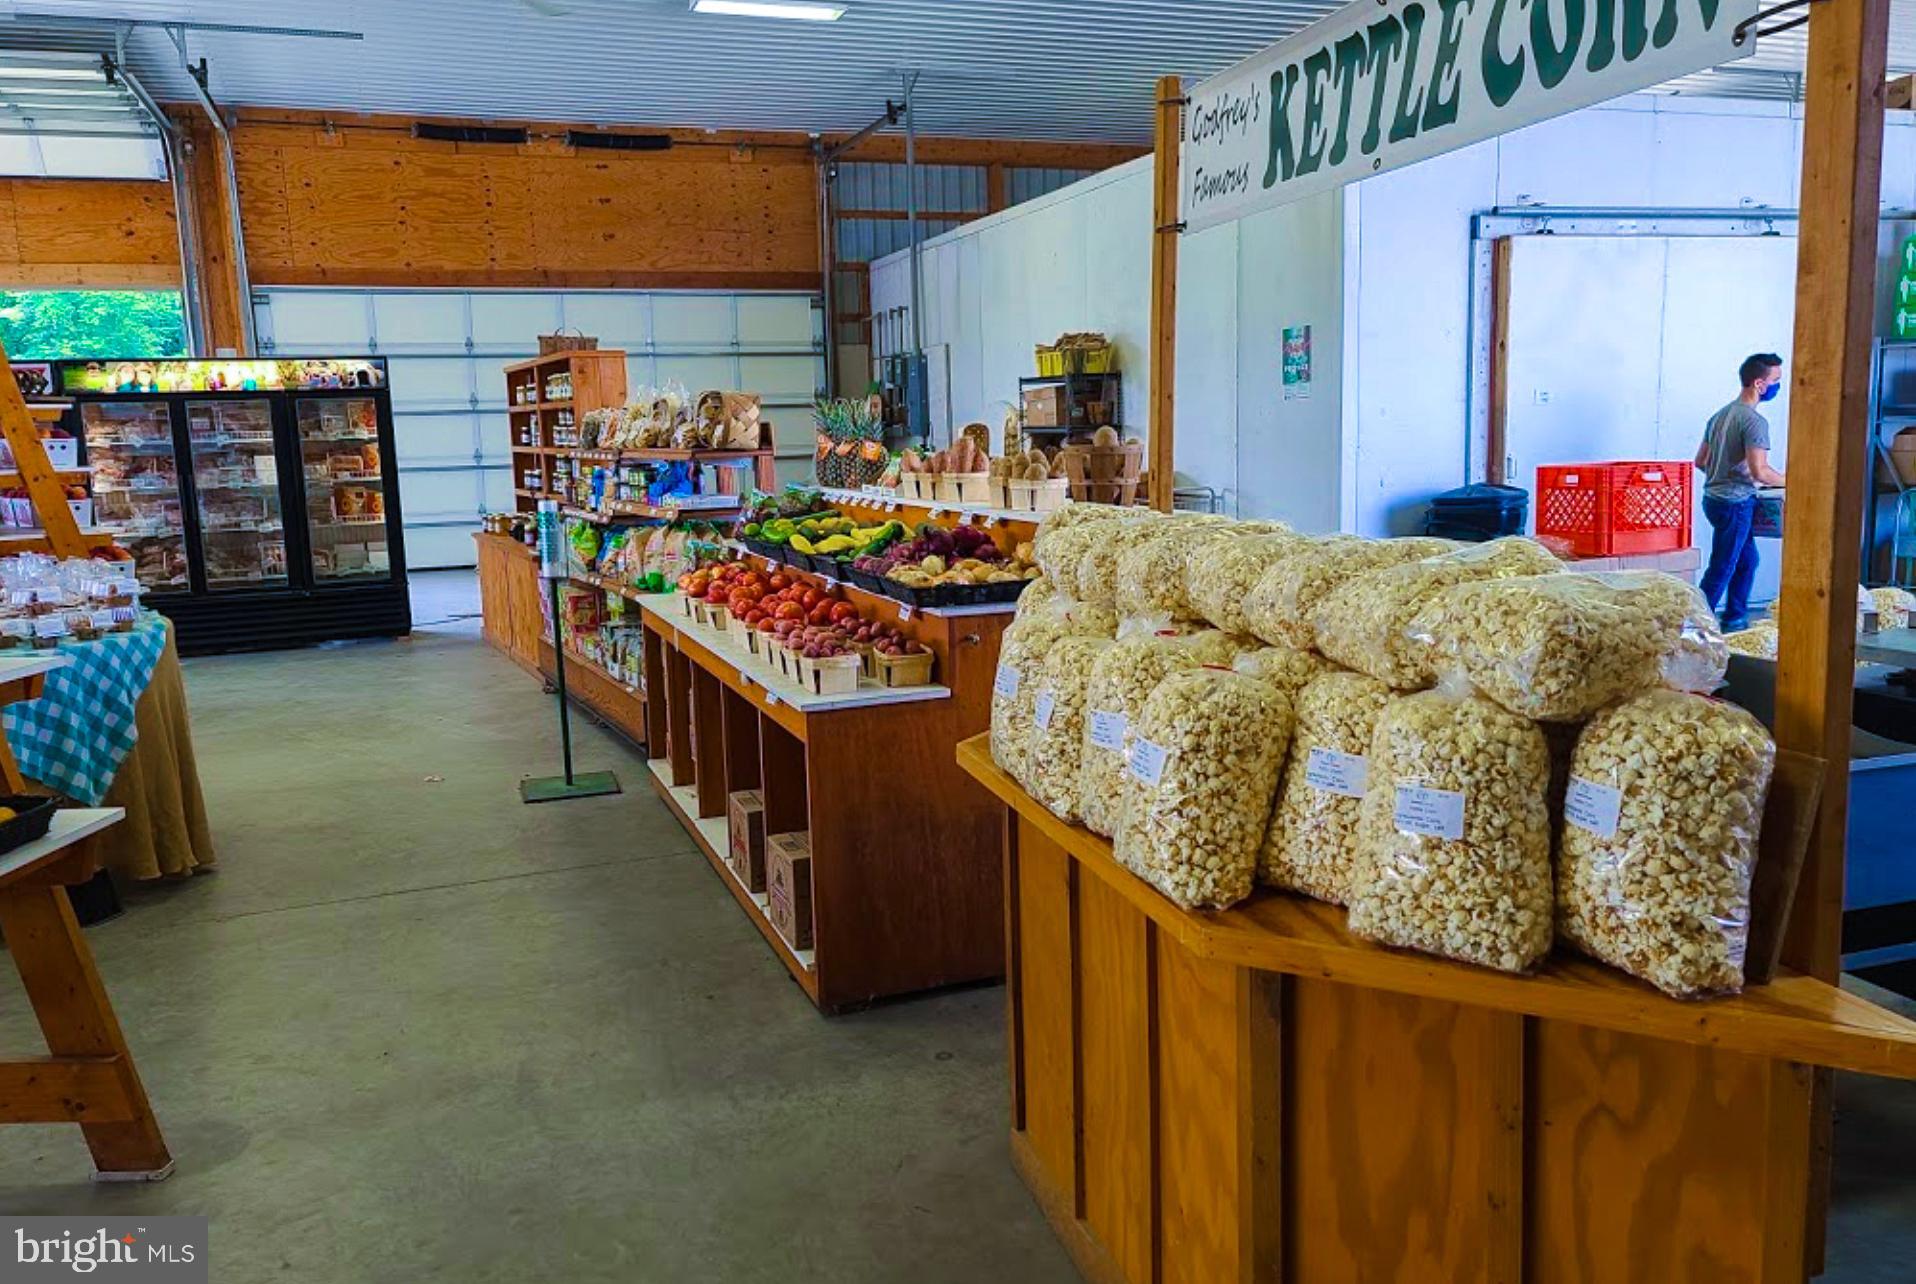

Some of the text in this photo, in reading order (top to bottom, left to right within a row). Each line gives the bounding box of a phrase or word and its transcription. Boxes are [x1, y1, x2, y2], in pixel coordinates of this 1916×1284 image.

[1192, 82, 1260, 146] Godfrey's
[1262, 0, 1474, 189] KETTLE
[1192, 162, 1249, 208] Famous
